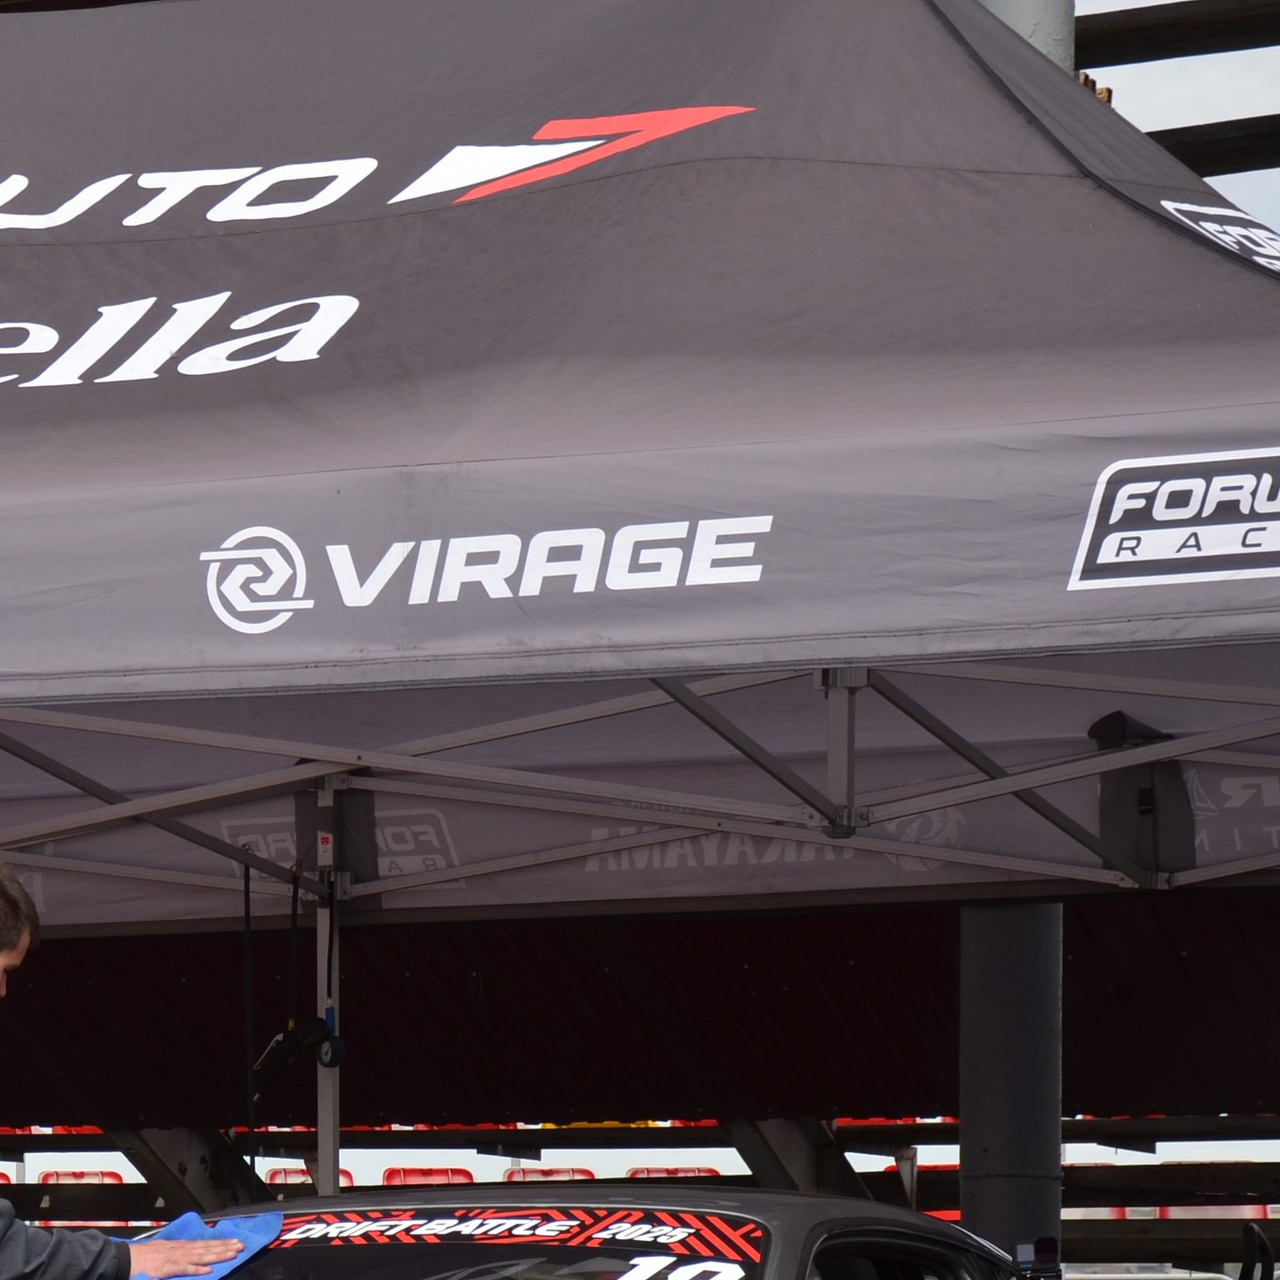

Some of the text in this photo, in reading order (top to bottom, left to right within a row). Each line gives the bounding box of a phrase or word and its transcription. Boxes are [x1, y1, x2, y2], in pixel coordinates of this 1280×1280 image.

[324, 515, 773, 608] VIRAGE
[282, 1219, 695, 1243] DRIFT BATTLE 2025
